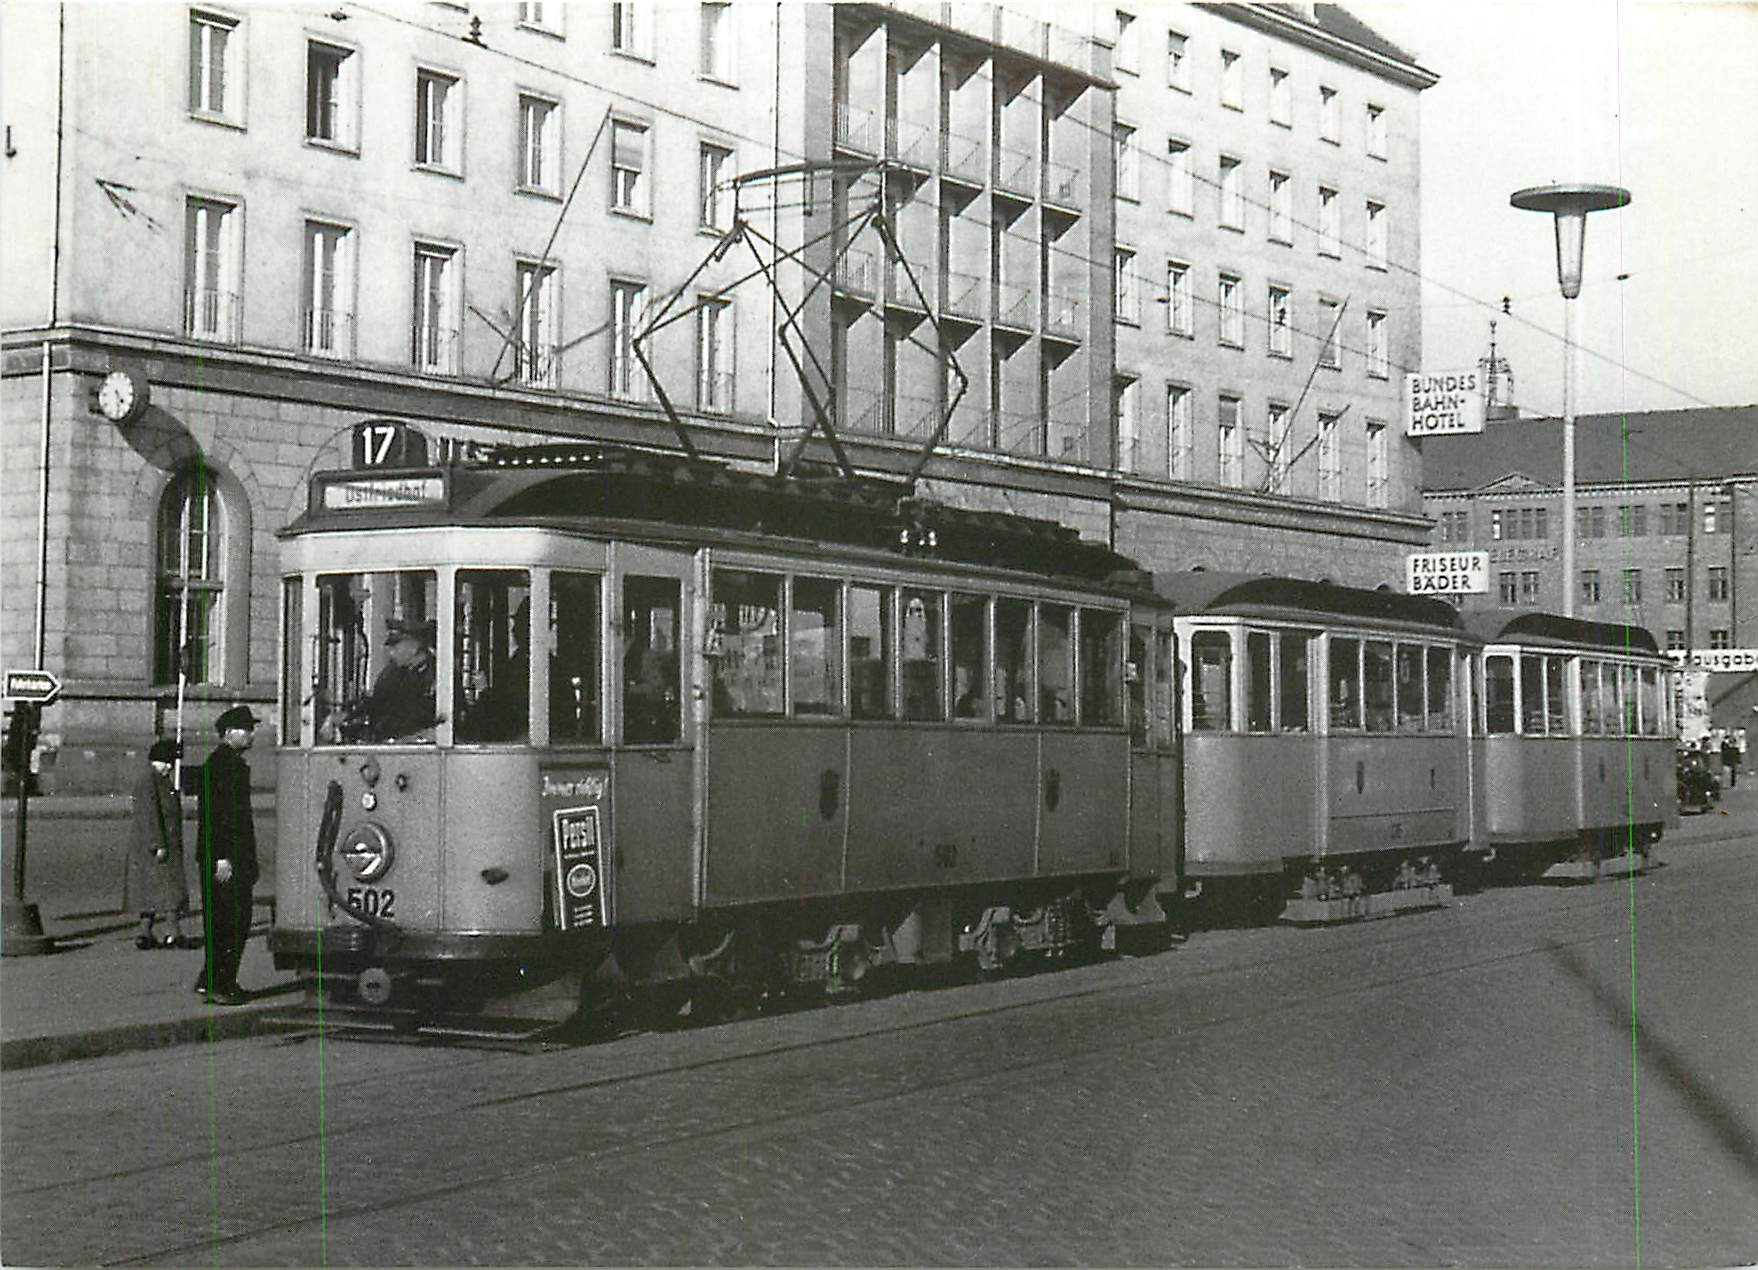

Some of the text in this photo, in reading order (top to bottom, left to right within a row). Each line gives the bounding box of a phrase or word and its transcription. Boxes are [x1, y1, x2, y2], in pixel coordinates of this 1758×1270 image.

[1412, 374, 1476, 394] BUNDES
[1412, 396, 1465, 412] BAHN-
[1412, 413, 1465, 430] HOTEL
[362, 426, 396, 465] 17
[1413, 556, 1481, 573] FRISEUR
[1413, 574, 1471, 591] BÄDER
[348, 888, 394, 918] 502
